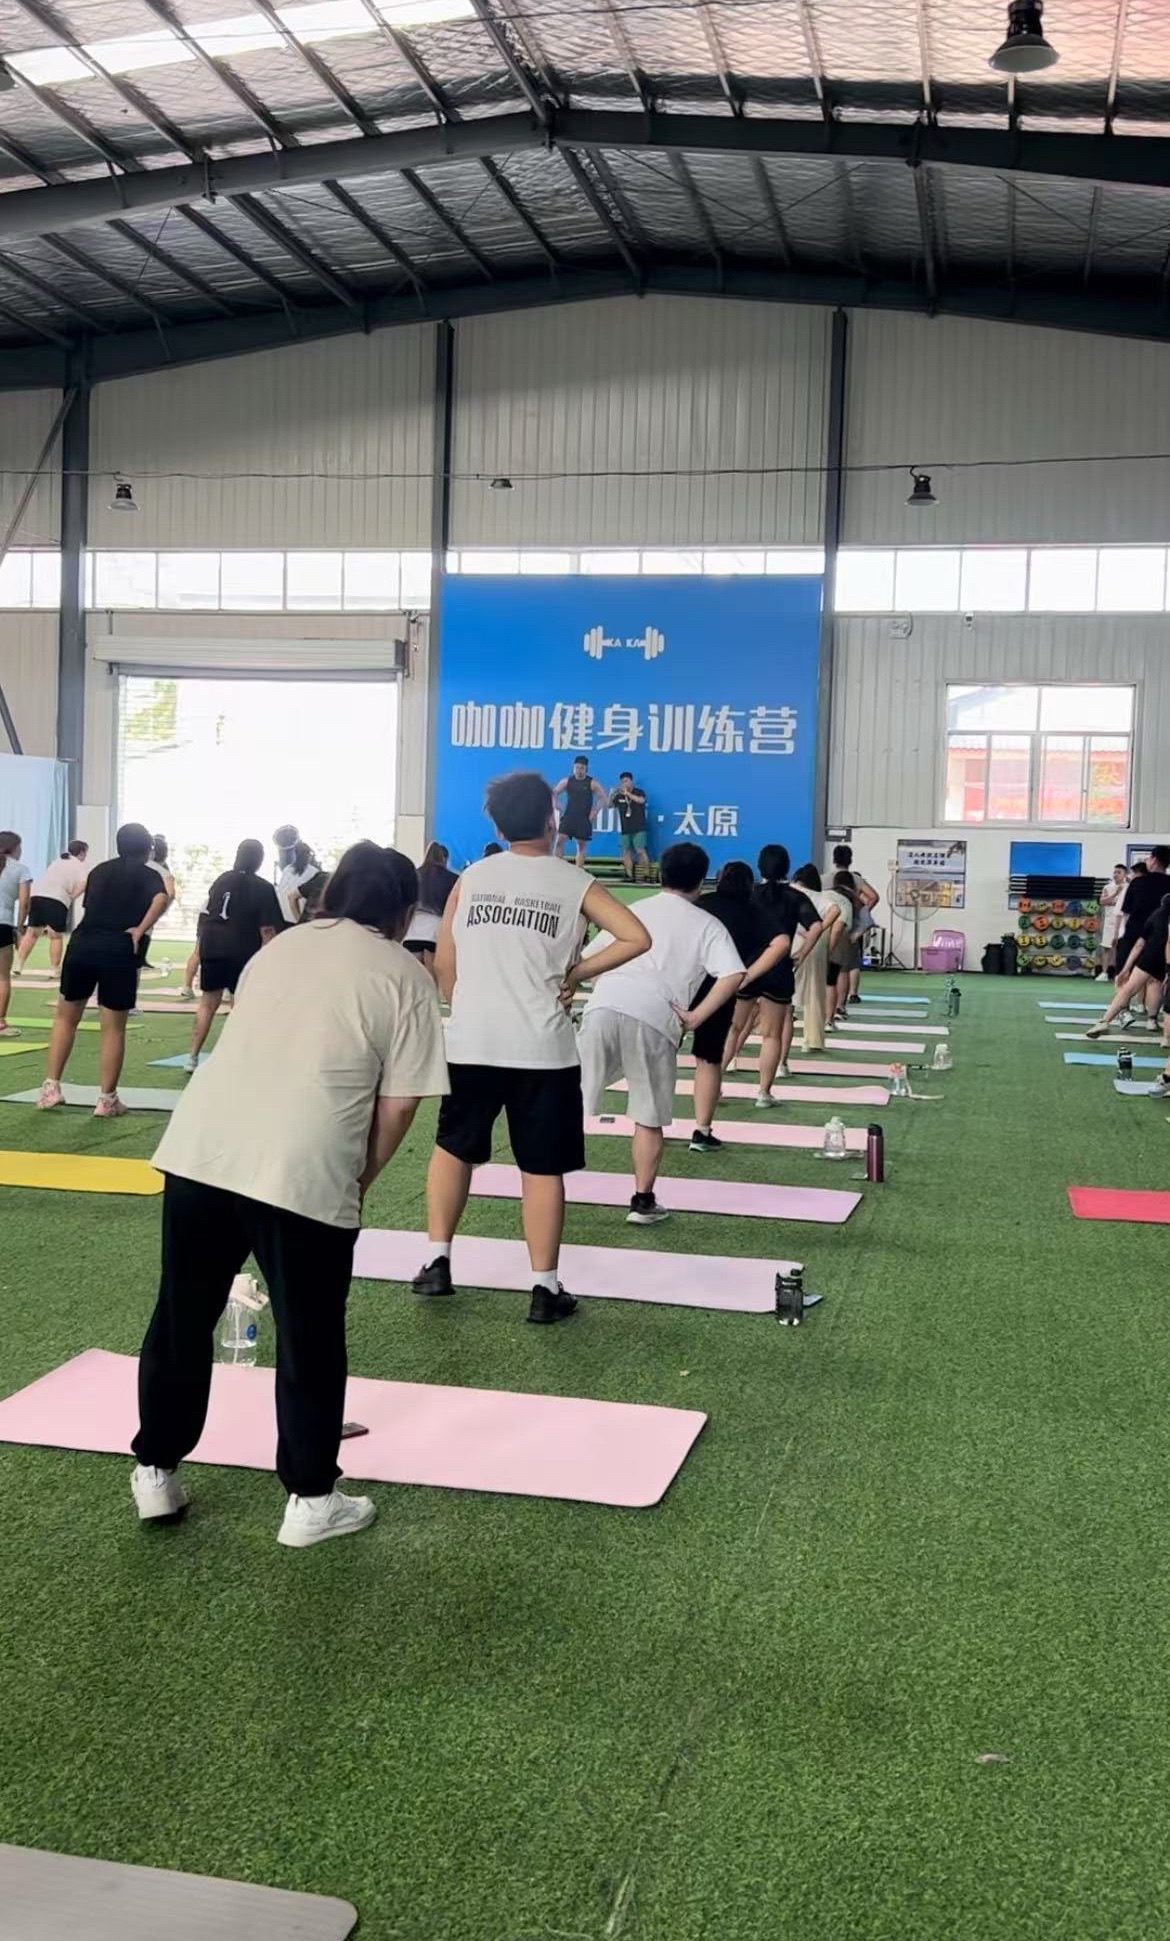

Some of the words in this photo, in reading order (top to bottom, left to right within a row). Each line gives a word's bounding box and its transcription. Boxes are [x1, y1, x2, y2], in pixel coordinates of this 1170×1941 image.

[450, 700, 798, 755] 咖咖健身训练营
[467, 904, 560, 938] ASSOCIATION
